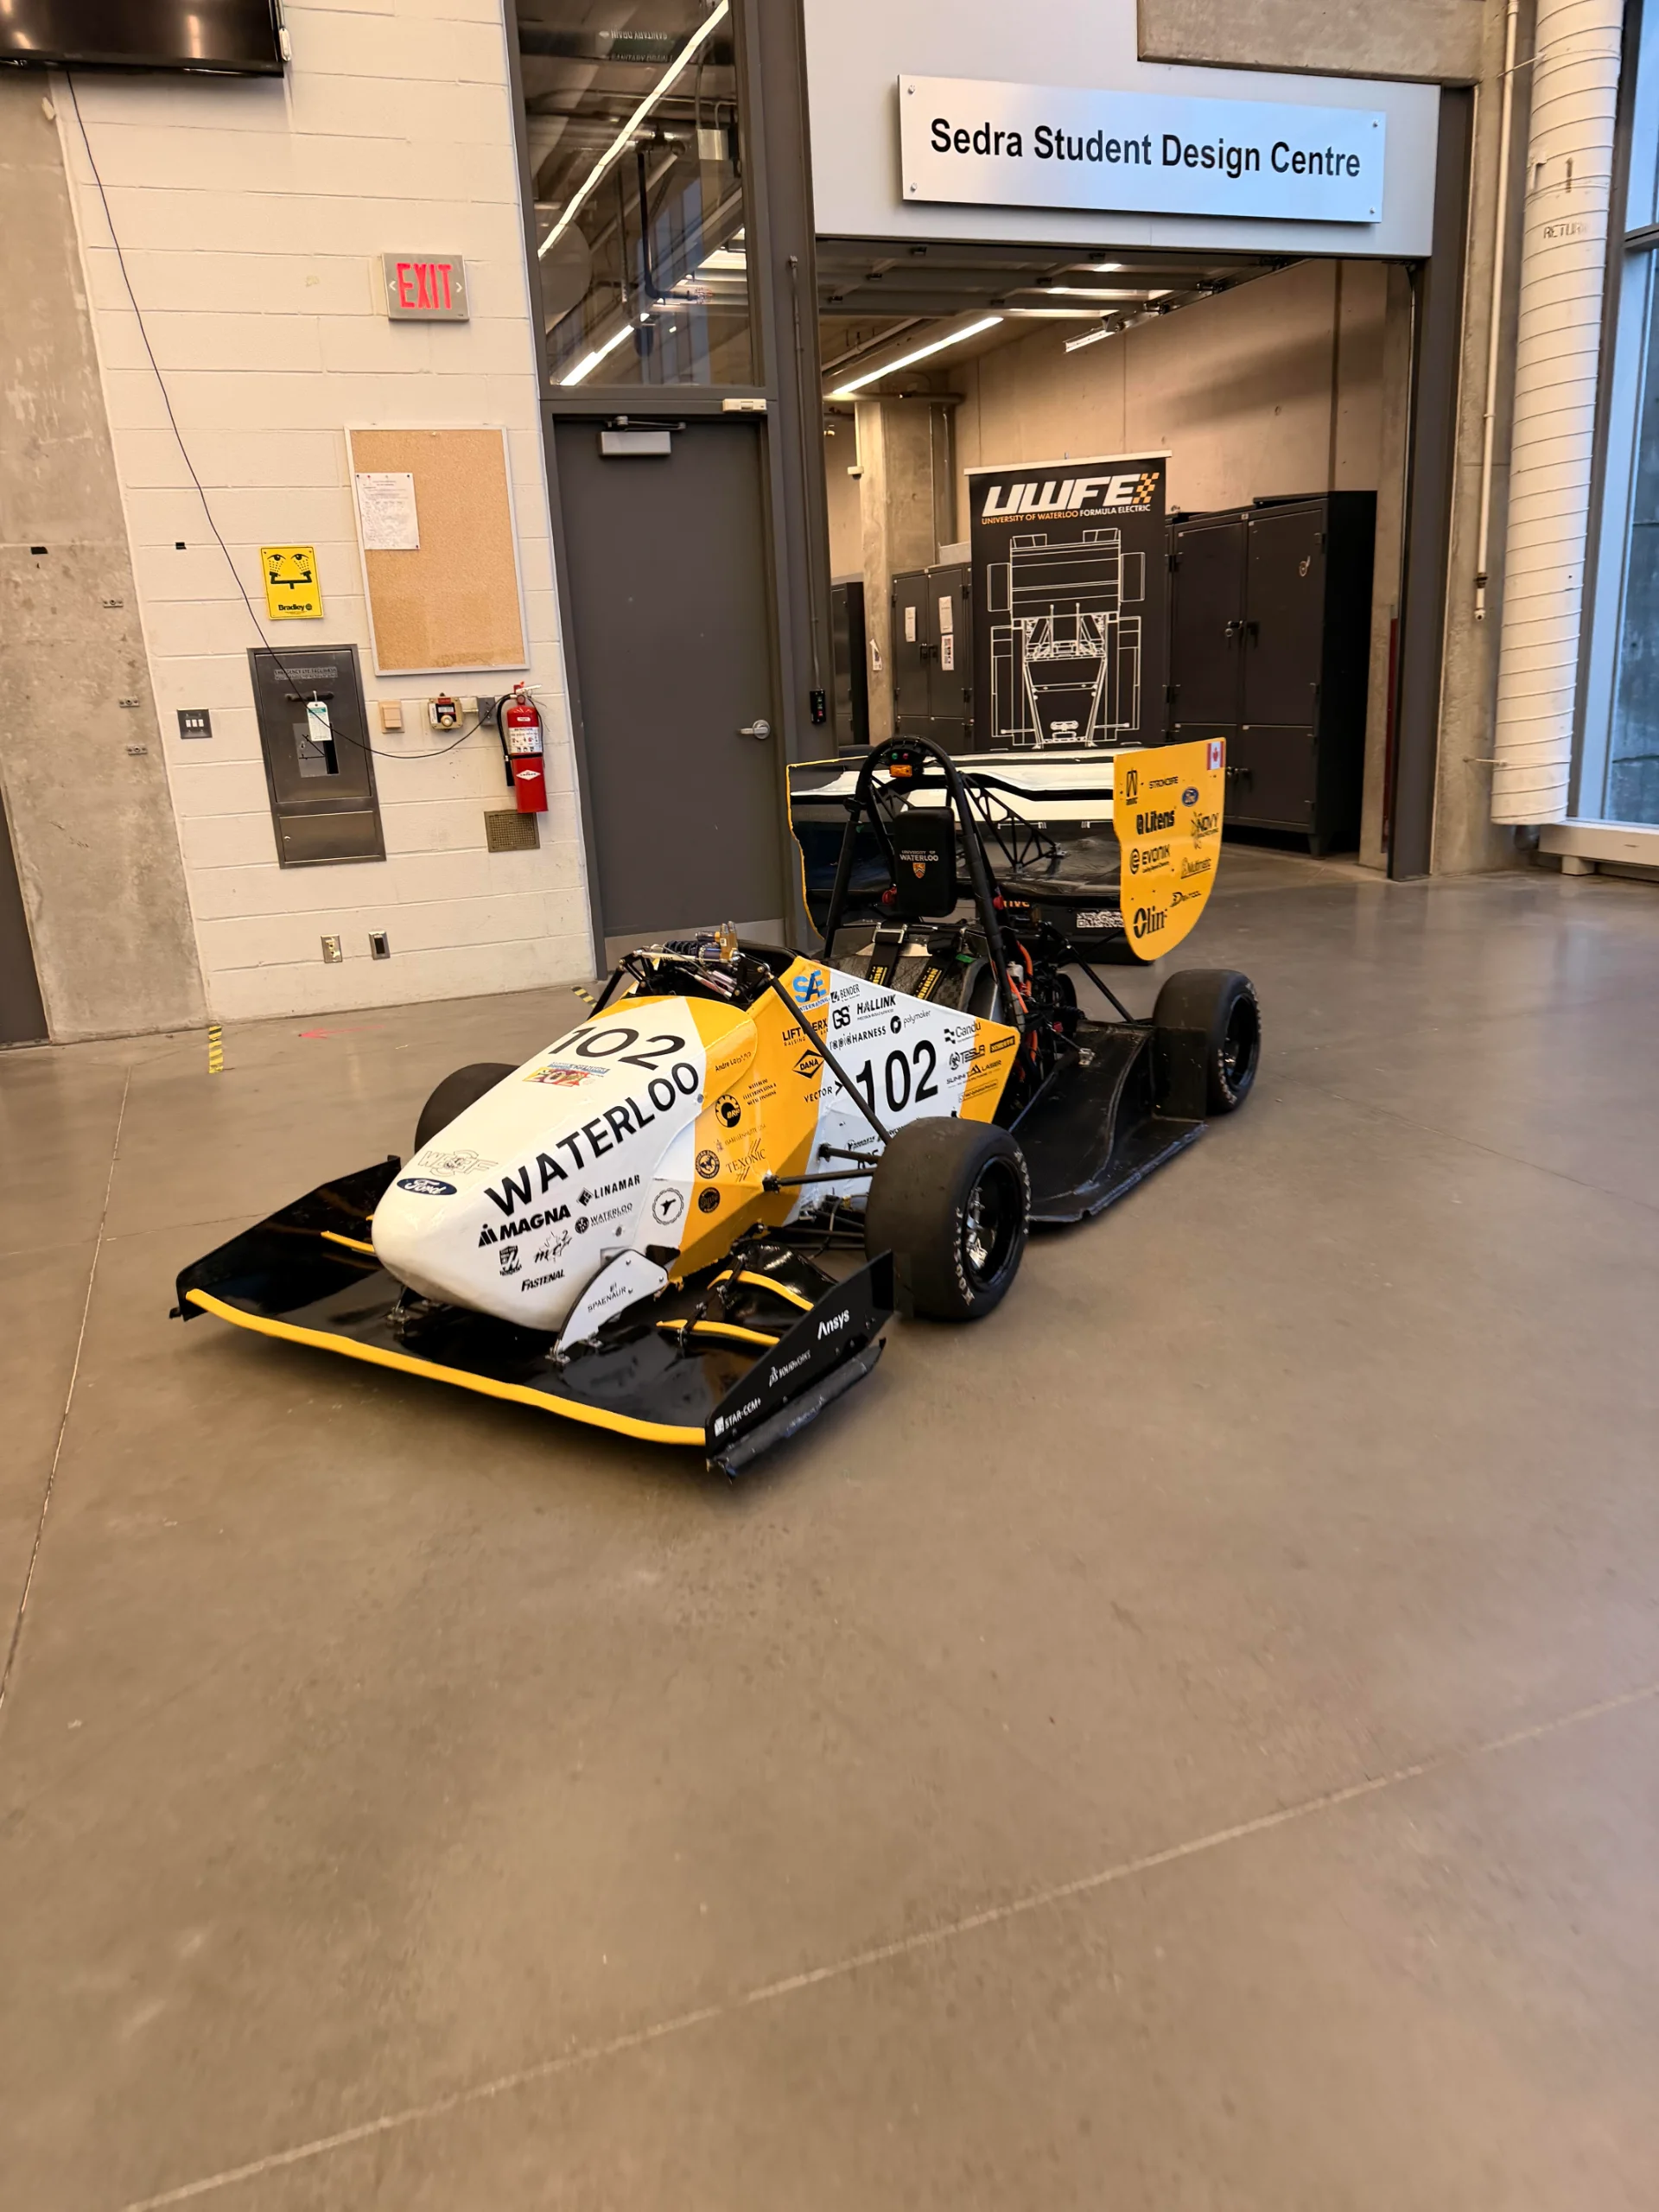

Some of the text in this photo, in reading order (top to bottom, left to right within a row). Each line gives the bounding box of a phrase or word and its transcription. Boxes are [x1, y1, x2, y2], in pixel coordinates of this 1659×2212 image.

[931, 118, 1361, 179] Sedra Student Design Centre
[397, 263, 452, 309] EXIT
[982, 474, 1141, 518] UWFE
[982, 514, 1024, 524] UNIVERSITY
[1037, 511, 1078, 520] WATERLOO
[1080, 507, 1116, 517] FORMULA
[1118, 505, 1151, 514] ELECTRIC
[1145, 810, 1174, 833] Litens
[792, 969, 827, 1003] SAE
[840, 983, 861, 999] BENDER
[856, 995, 897, 1015] HALLINK
[832, 1006, 851, 1030] GS
[903, 1009, 931, 1028] polymaker
[548, 1027, 685, 1071] 102
[785, 1037, 805, 1046] RAISING
[800, 1058, 819, 1071] DANA
[856, 1040, 938, 1116] 102
[804, 1086, 832, 1103] VECTOR
[484, 1062, 699, 1217] WATERLOO
[726, 1149, 766, 1173] TEXONIC
[404, 1179, 447, 1194] Ford
[594, 1174, 640, 1199] LINAMAR
[500, 1205, 571, 1241] MAGNA
[590, 1202, 632, 1224] WATERLOO
[521, 1268, 565, 1293] FASTENAL
[588, 1286, 626, 1313] SPAENAUR
[817, 1309, 850, 1340] Ansys
